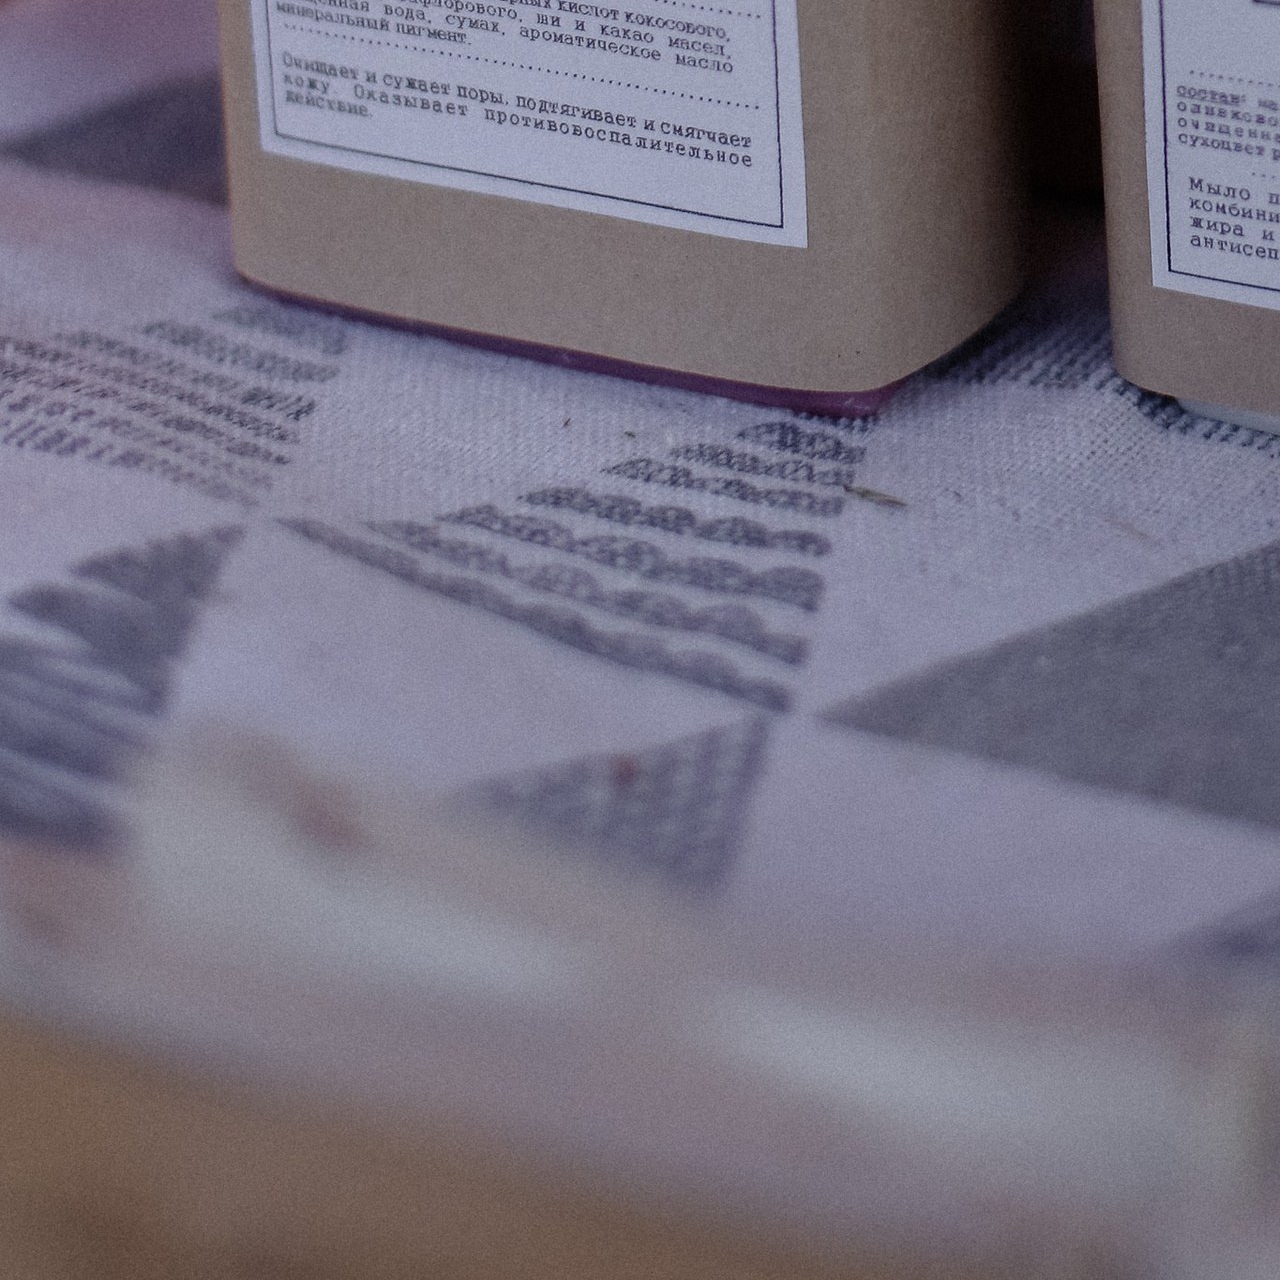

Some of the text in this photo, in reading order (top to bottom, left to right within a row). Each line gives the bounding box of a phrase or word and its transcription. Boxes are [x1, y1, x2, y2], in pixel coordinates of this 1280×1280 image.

[276, 0, 391, 32] минеральный
[557, 0, 620, 21] кислот
[624, 10, 732, 42] кокосового,
[384, 3, 432, 25] вода,
[444, 13, 507, 37] сумах,
[519, 25, 662, 61] ароматическое
[675, 53, 735, 74] масло
[536, 12, 562, 28] ши
[574, 19, 587, 32] и
[600, 23, 655, 44] какао
[667, 36, 733, 60] масел,
[281, 51, 753, 149] Очищает и сужает поры, подтягивает и смягчает
[1176, 85, 1247, 108] состав:
[353, 84, 469, 117] Оказывает
[484, 107, 753, 168] противовоспалительное
[1177, 132, 1267, 156] сухоцвет
[1188, 176, 1252, 201] Мыло
[1189, 215, 1246, 238] жира
[1261, 230, 1275, 243] и
